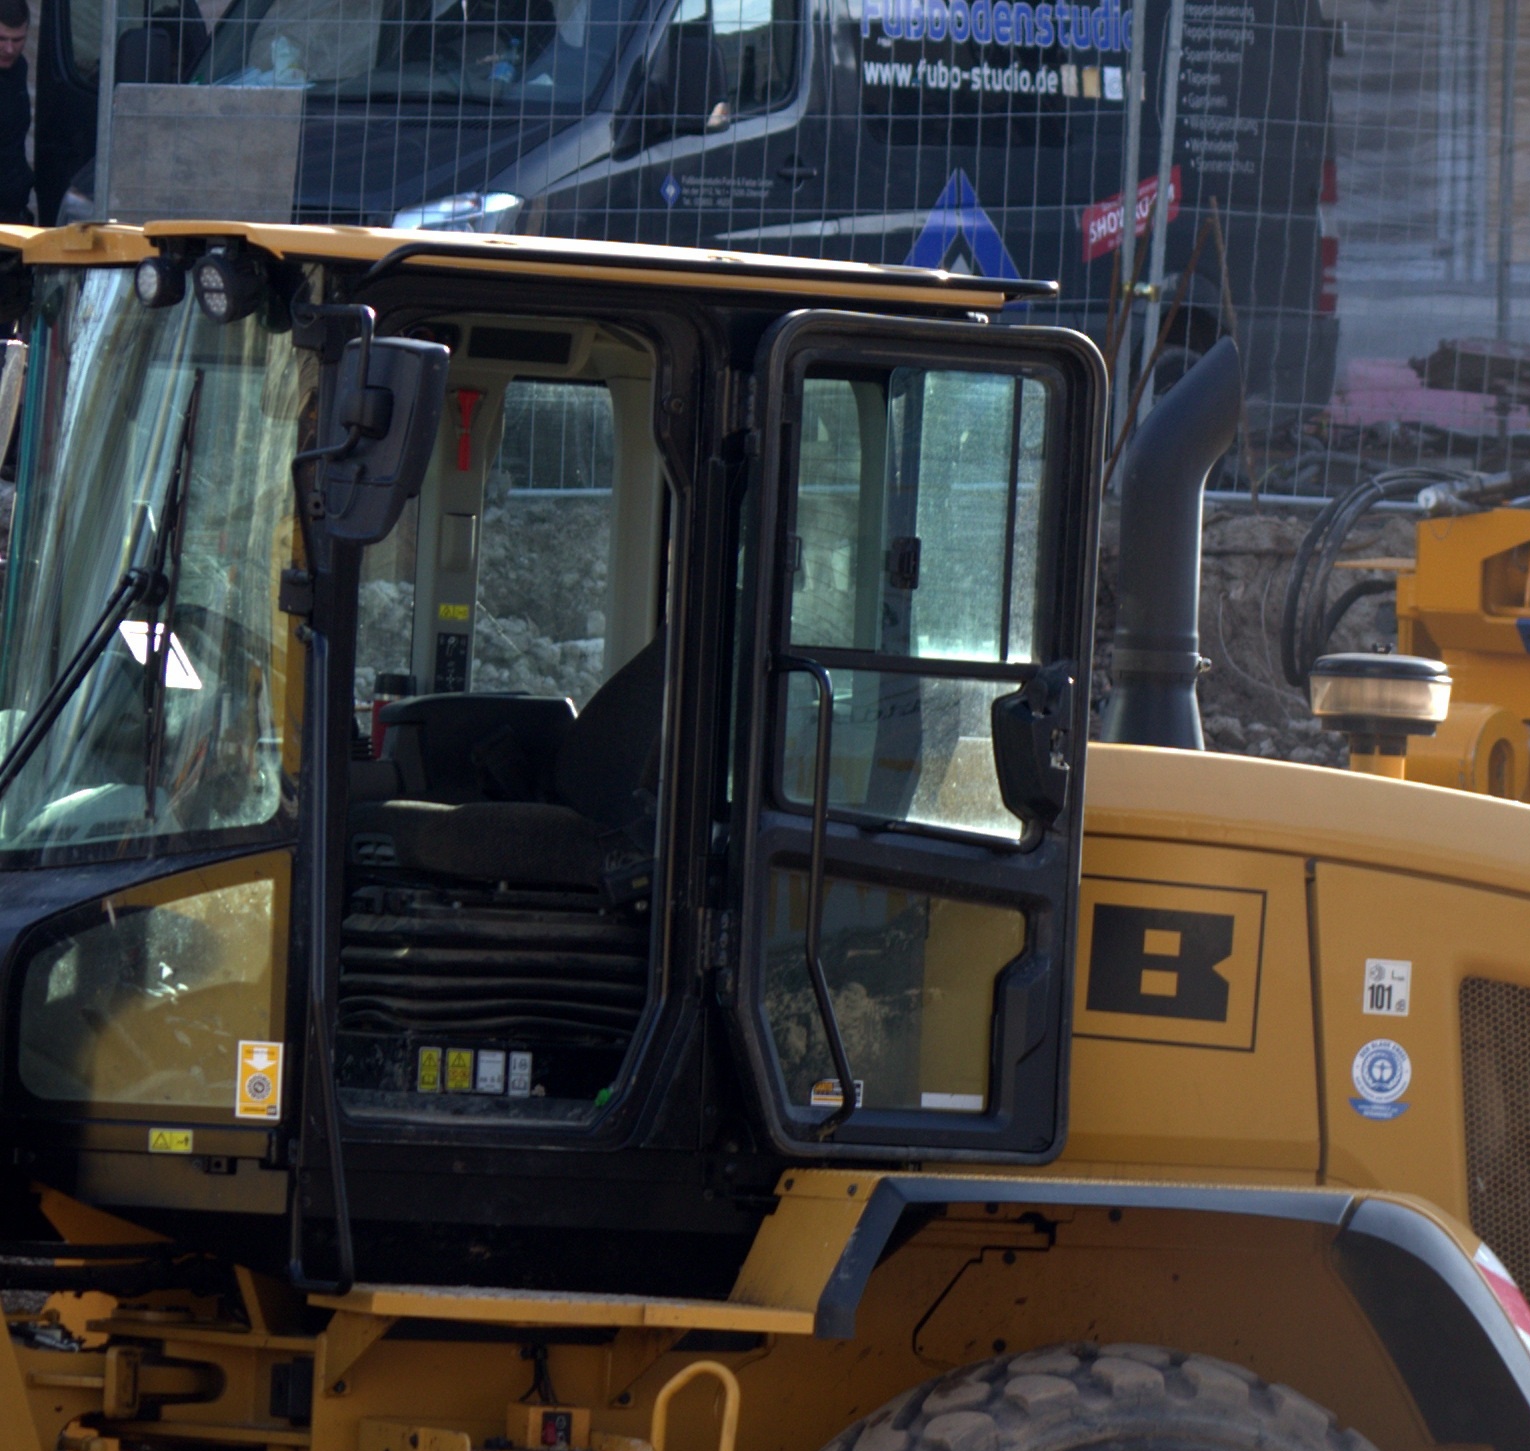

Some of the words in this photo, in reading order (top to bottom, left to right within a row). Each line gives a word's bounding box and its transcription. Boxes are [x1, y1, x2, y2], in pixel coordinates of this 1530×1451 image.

[864, 59, 1059, 93] www.fubo-studio.de
[1086, 903, 1234, 1023] B
[1368, 983, 1392, 1011] 101
